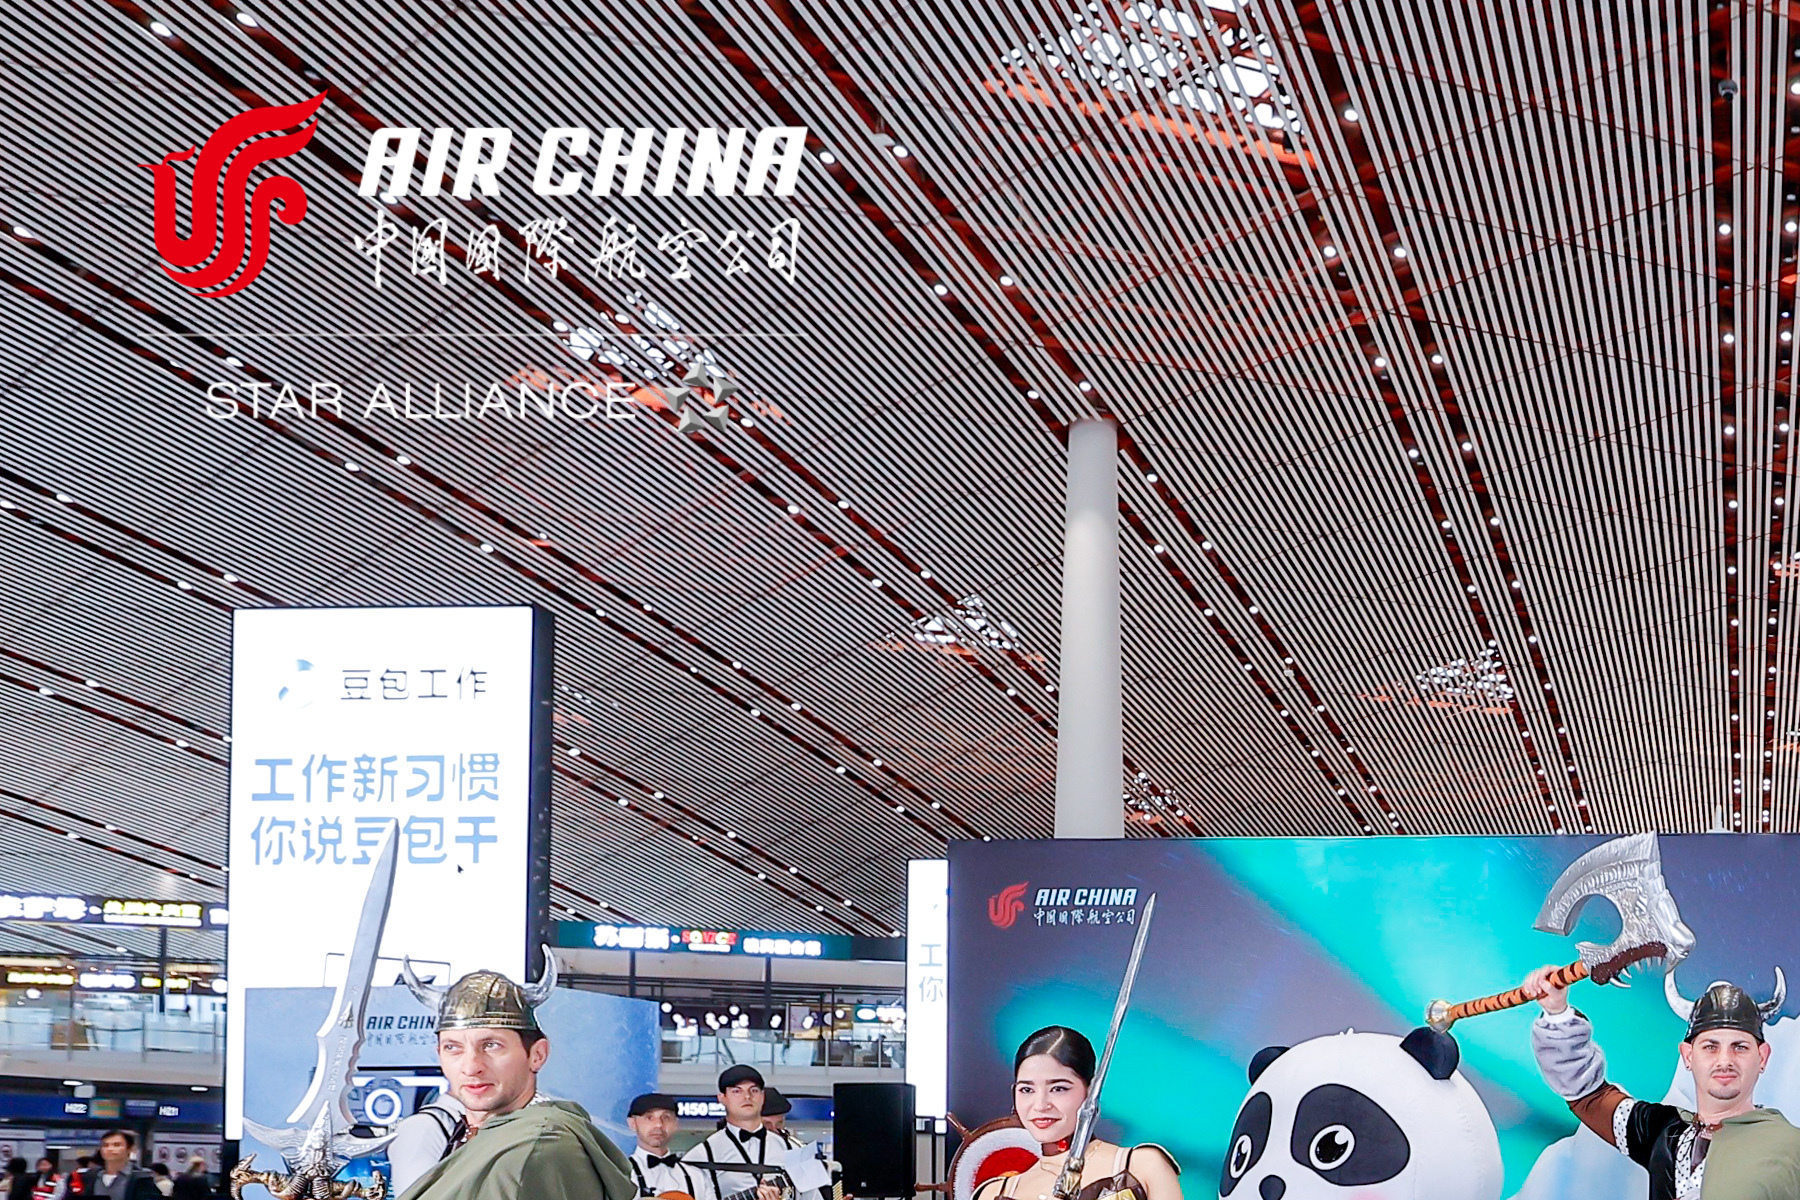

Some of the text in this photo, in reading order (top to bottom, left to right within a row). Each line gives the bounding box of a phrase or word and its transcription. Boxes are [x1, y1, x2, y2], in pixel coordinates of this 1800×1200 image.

[340, 667, 488, 700] 豆包工作
[251, 753, 500, 803] 工作新习惯
[250, 815, 499, 866] 你说豆包干
[1034, 888, 1138, 906] AIR CHINA
[366, 1015, 436, 1030] AIR CHIN
